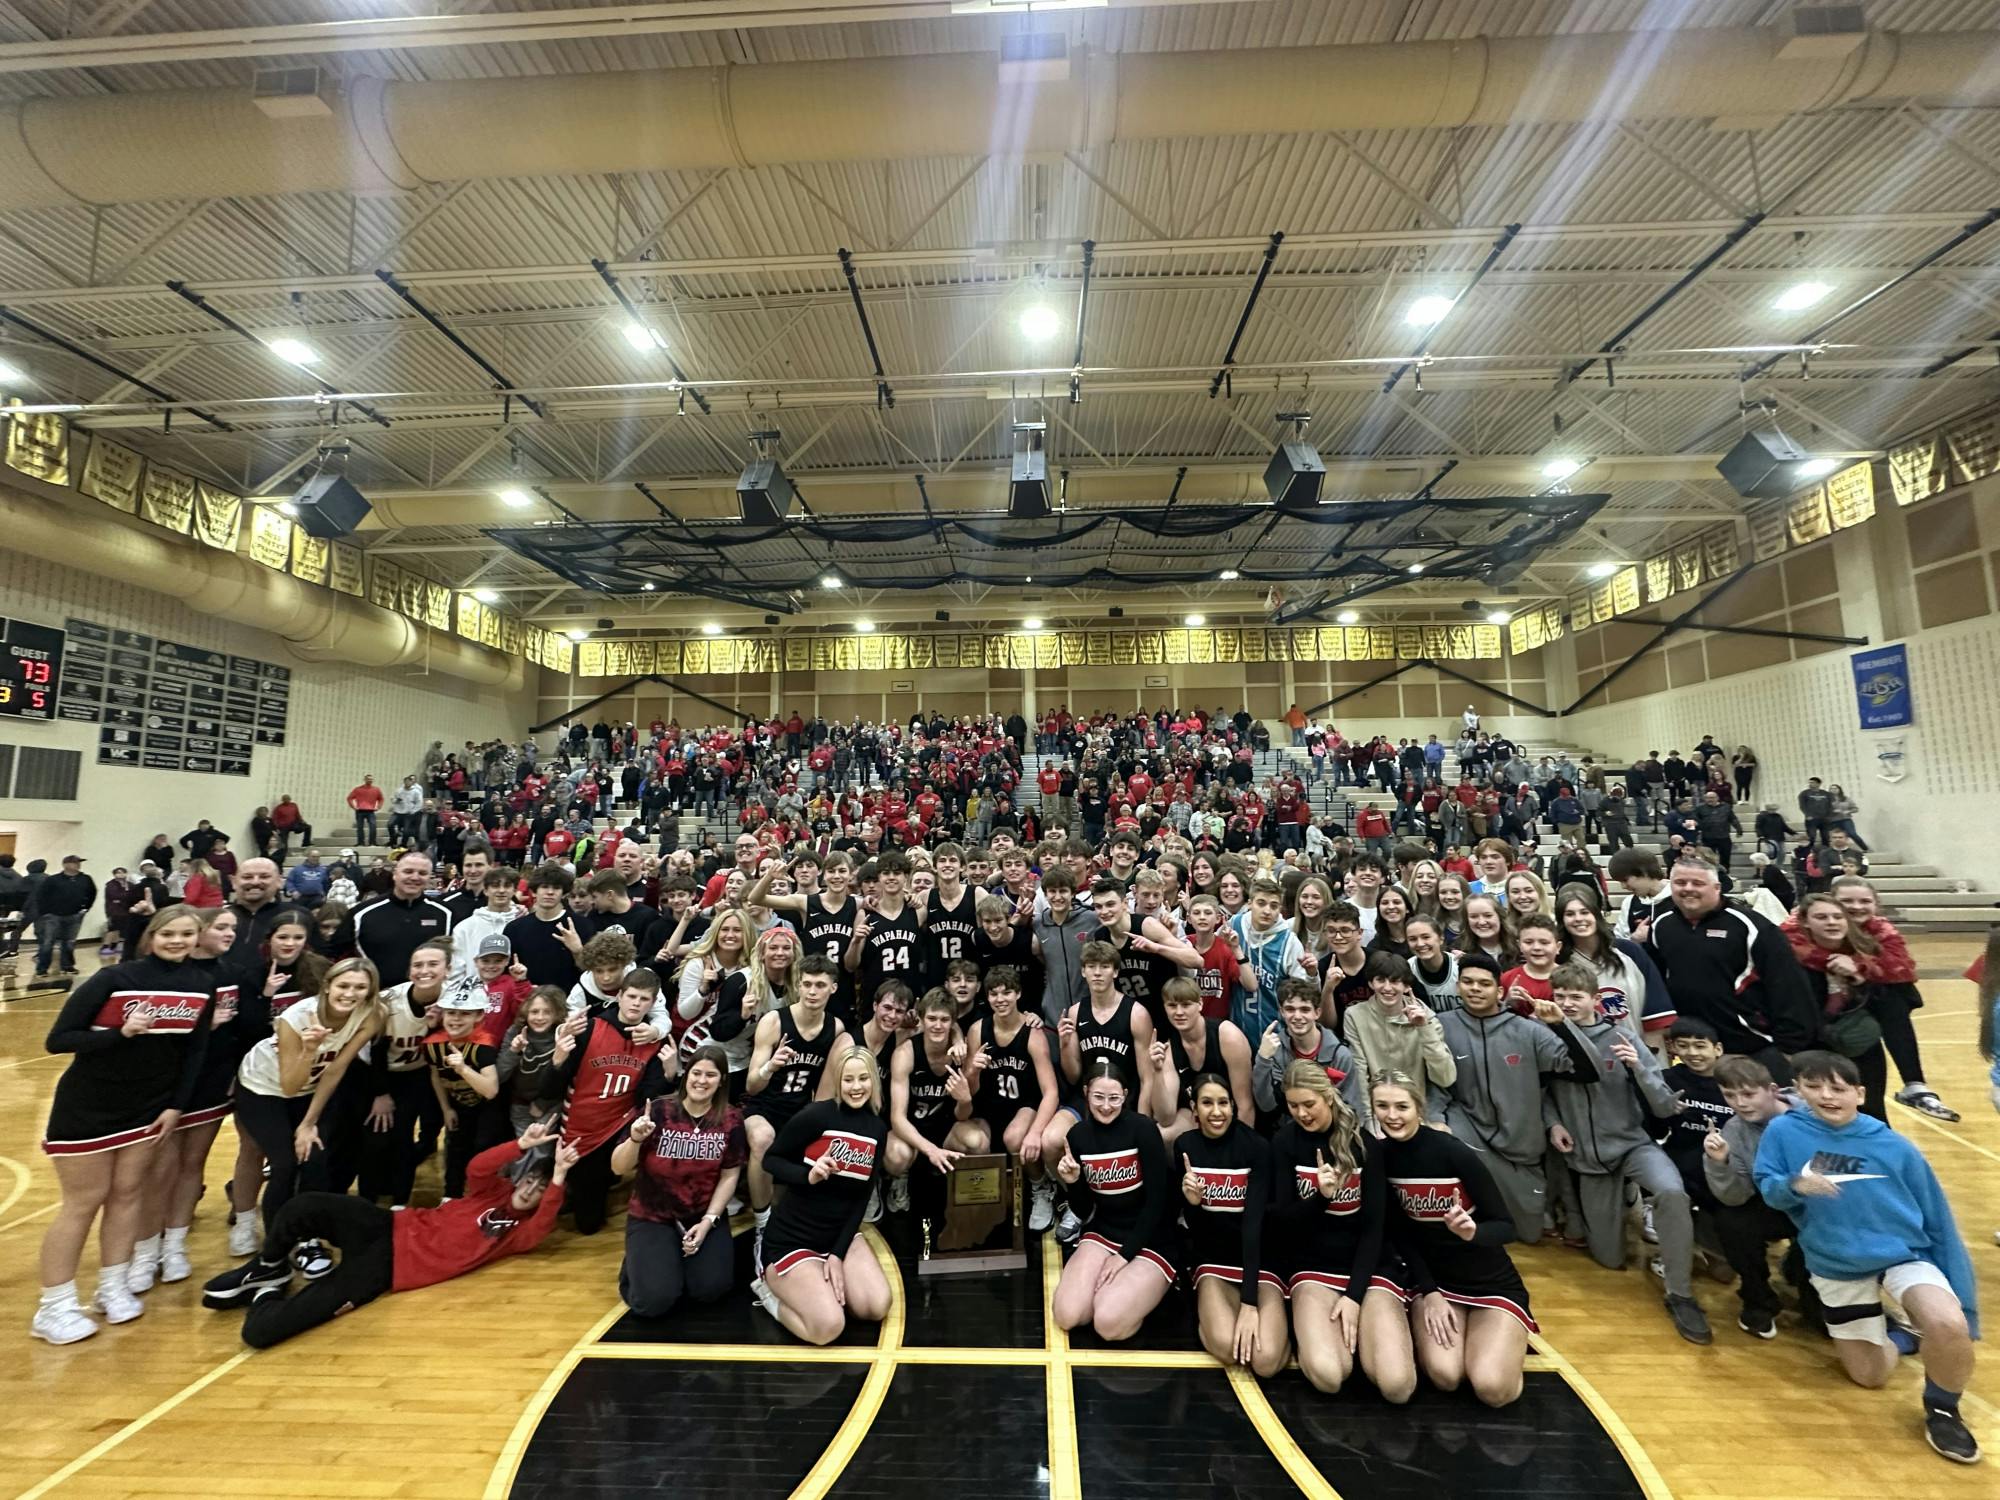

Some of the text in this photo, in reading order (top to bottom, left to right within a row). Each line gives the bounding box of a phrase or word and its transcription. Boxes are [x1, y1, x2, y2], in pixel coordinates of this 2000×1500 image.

[11, 646, 49, 660] GUEST
[1855, 655, 1903, 670] MEMBER
[19, 659, 50, 683] 73
[32, 692, 44, 708] 5
[809, 923, 852, 939] WAPAHAN
[871, 929, 917, 948] WAPAHANI
[930, 921, 973, 935] WAPAHANI
[826, 940, 840, 963] 2
[941, 936, 962, 958] 12
[881, 945, 910, 972] 24
[1119, 974, 1150, 998] 22
[1080, 1035, 1129, 1056] WAPAHANI
[599, 1072, 631, 1099] 10
[782, 1070, 810, 1093] 15
[997, 1074, 1020, 1100] 10
[1684, 1098, 1735, 1116] UNDER
[662, 1128, 725, 1141] WAPAHANI
[656, 1135, 726, 1160] RAIDERS
[1811, 1150, 1868, 1173] NIKE
[1082, 1159, 1138, 1189] Wapahani
